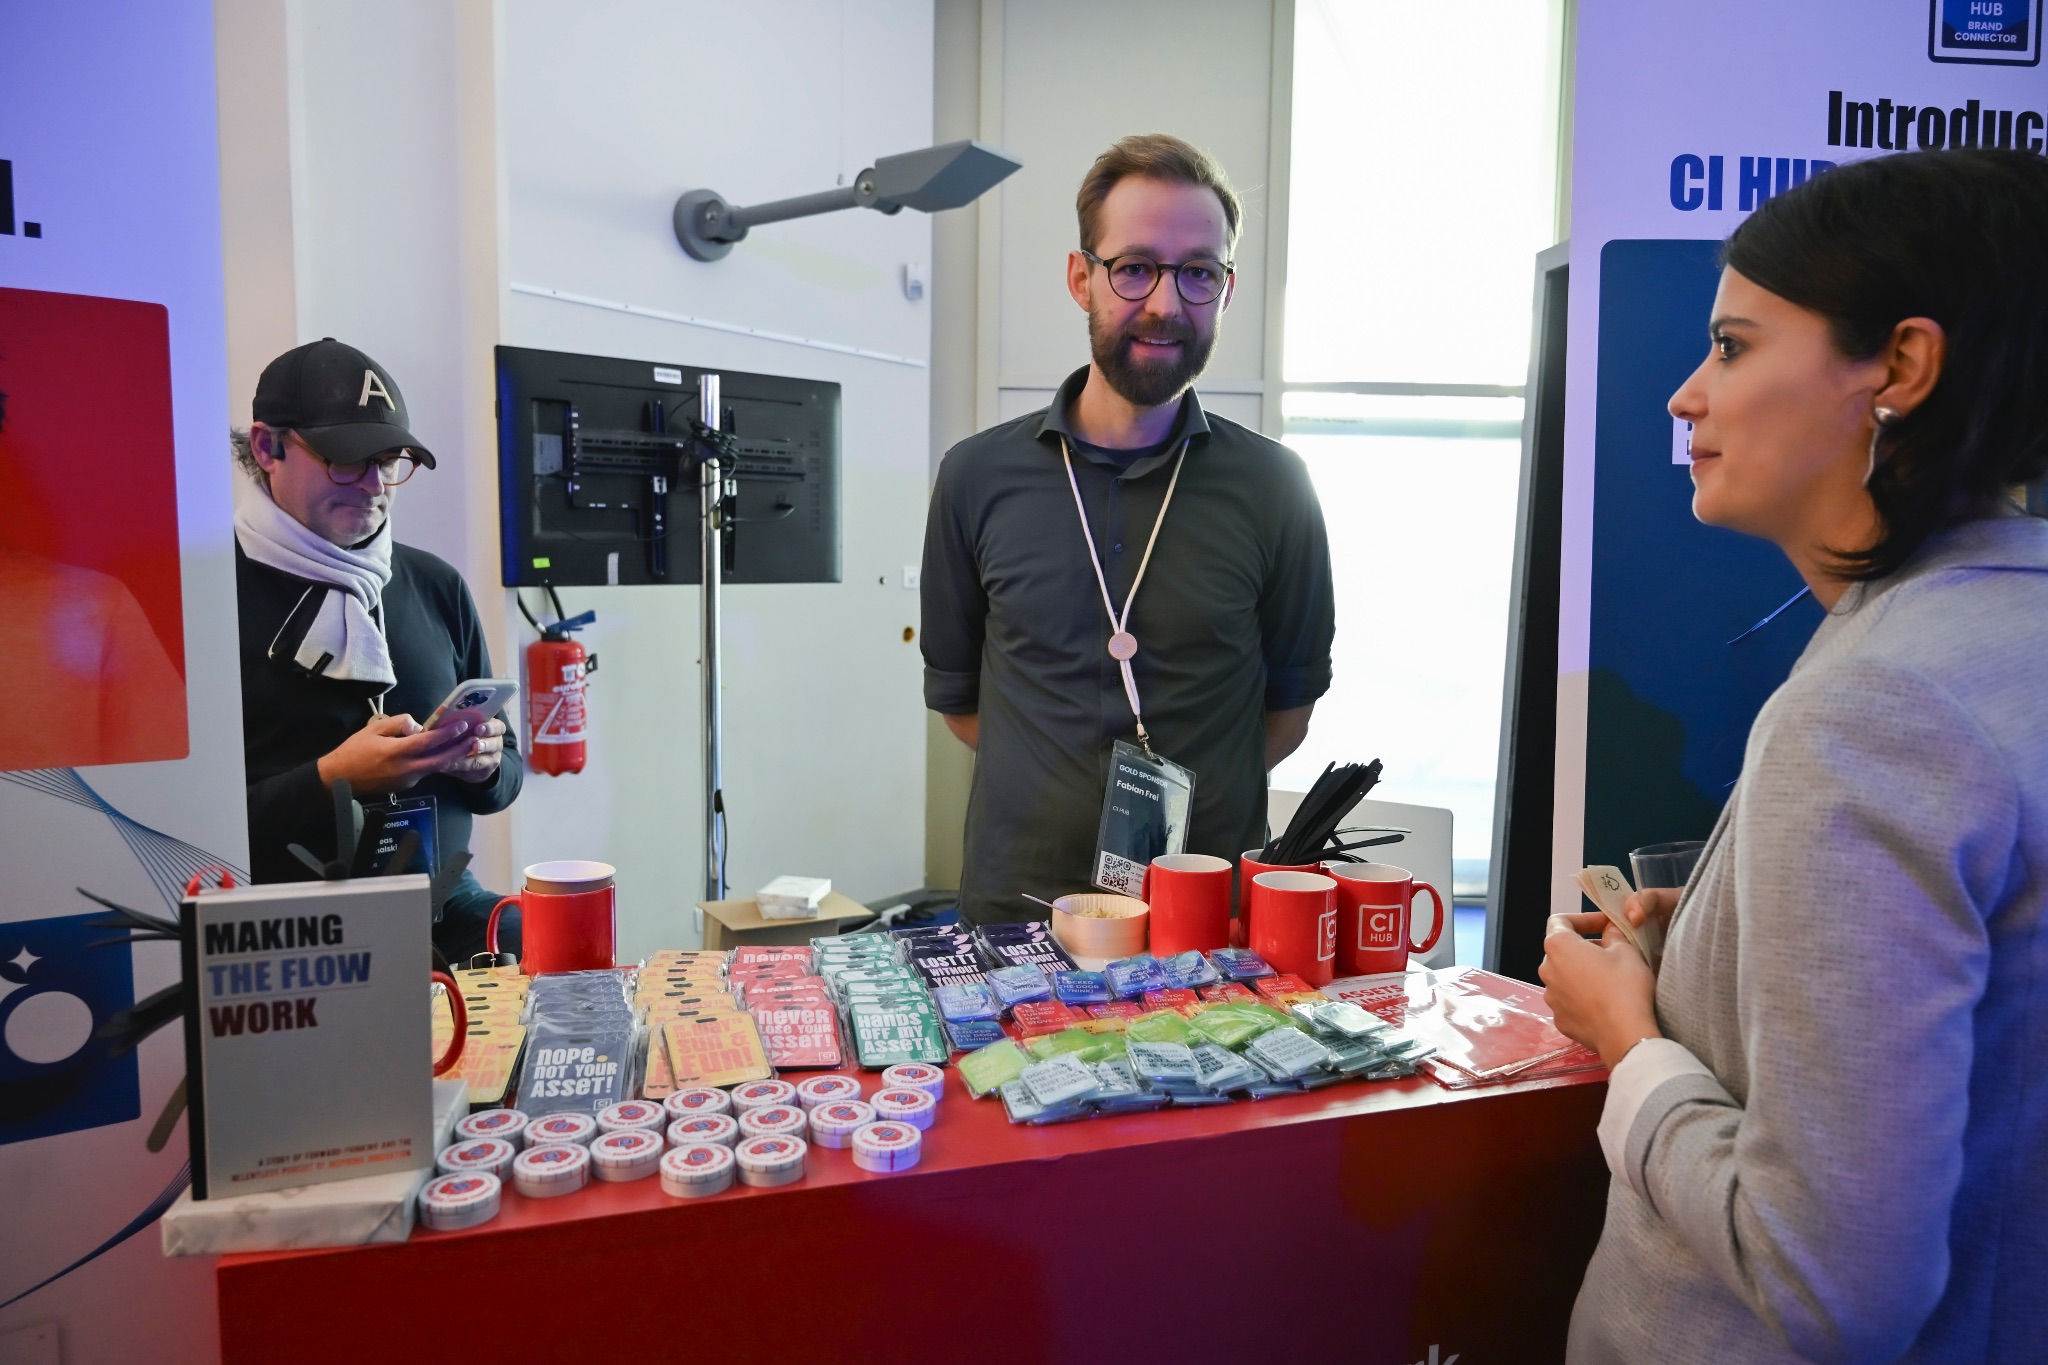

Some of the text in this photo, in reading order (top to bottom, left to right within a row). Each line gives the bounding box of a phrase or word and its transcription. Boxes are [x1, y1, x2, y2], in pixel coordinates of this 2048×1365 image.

[1970, 2, 2003, 16] HUB
[1968, 21, 2003, 31] BRAND
[1954, 32, 2018, 44] CONNECTOR
[1828, 91, 2048, 154] Introduc
[1670, 154, 1724, 212] CI
[359, 369, 396, 412] A
[1119, 764, 1169, 788] GOLD SPONSOR
[1116, 780, 1160, 802] Fabian Frei
[1370, 913, 1394, 932] CI
[204, 914, 343, 956] MAKING
[1371, 933, 1392, 942] HUB
[918, 952, 977, 968] LOSTTT
[206, 952, 372, 996] THE FLOW
[929, 964, 980, 976] WITHOUT
[1338, 985, 1404, 999] ASSETS
[209, 998, 318, 1038] WORK
[860, 1028, 890, 1040] OFF
